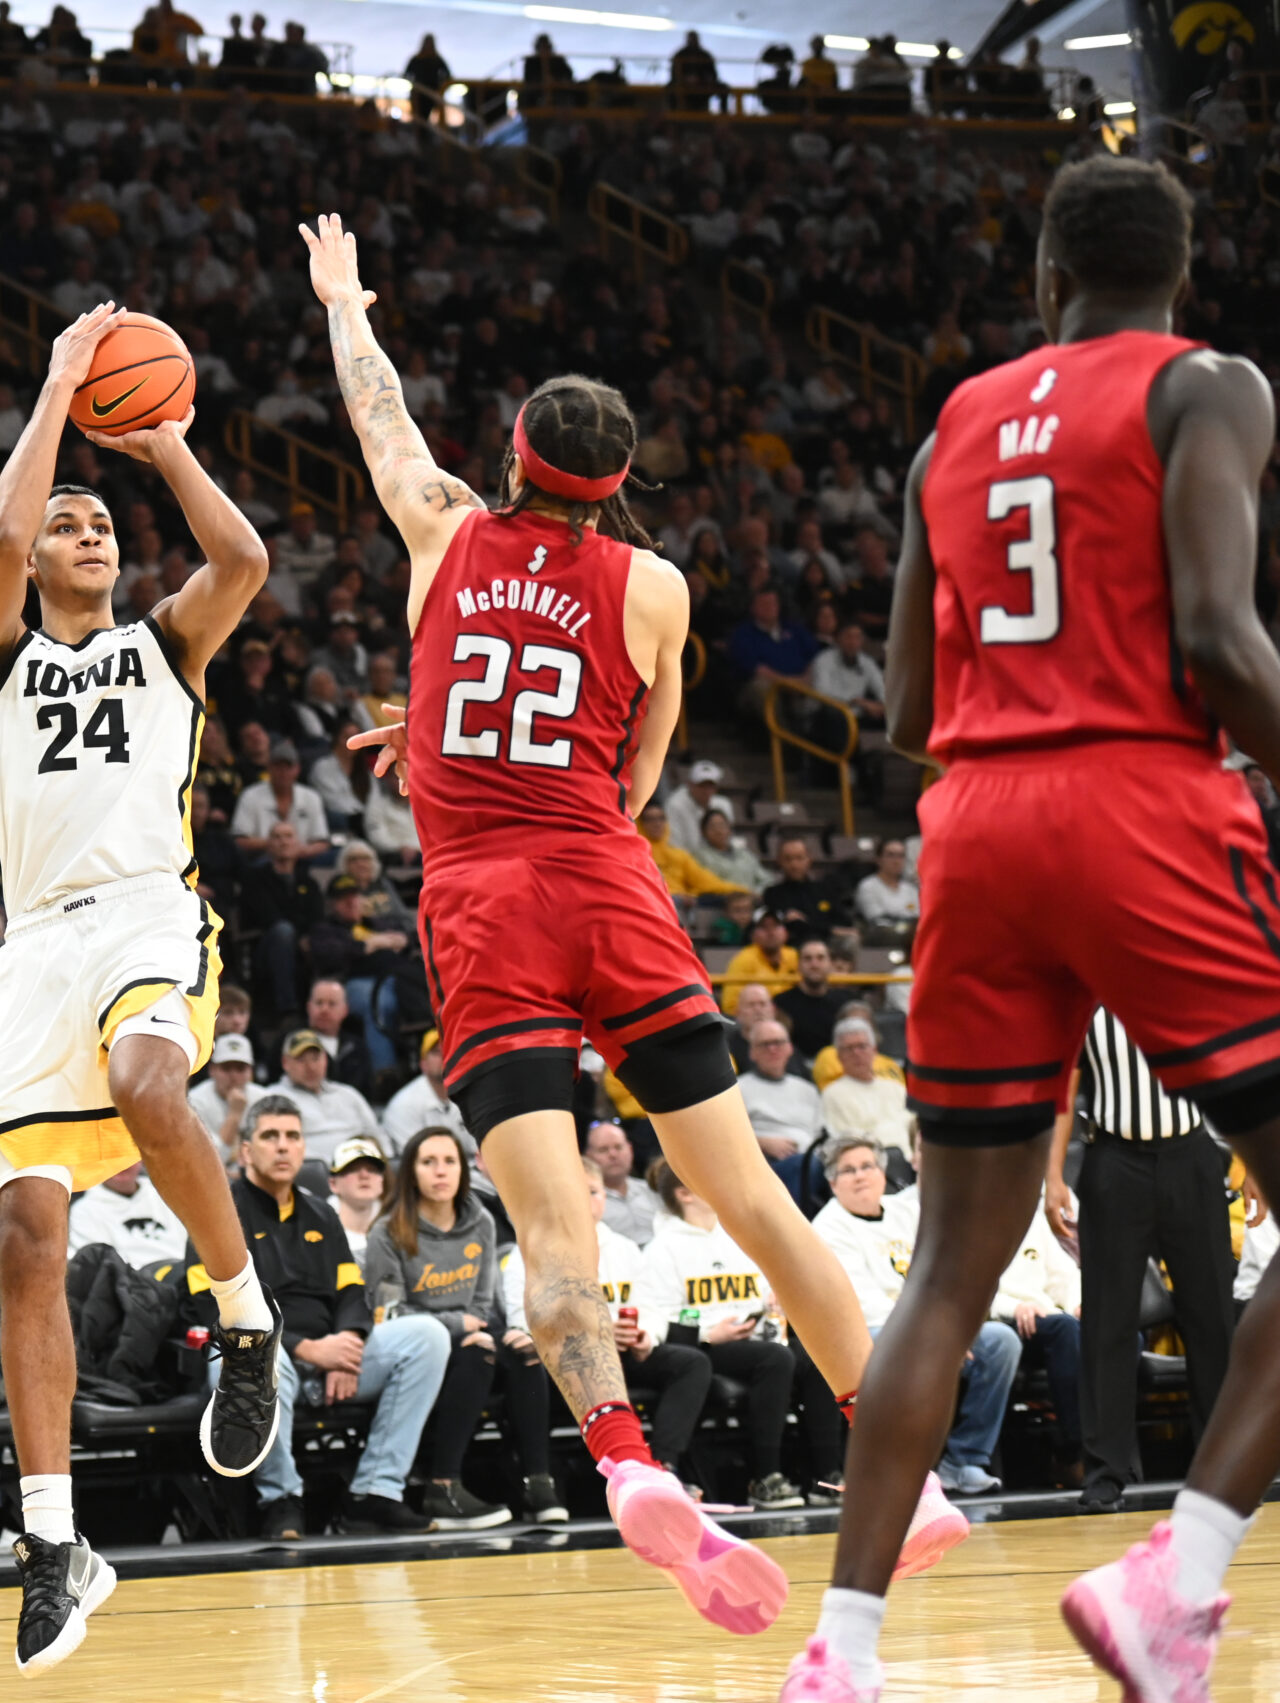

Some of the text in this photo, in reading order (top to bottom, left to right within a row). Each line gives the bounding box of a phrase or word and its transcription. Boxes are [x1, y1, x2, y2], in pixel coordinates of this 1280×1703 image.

[999, 414, 1060, 462] MAG
[980, 475, 1062, 644] 3
[456, 579, 592, 639] McCONNELL
[23, 648, 147, 698] IOWA
[441, 633, 583, 769] 22
[36, 698, 130, 775] 24
[63, 895, 96, 913] HAWKS
[685, 1274, 761, 1306] IOWA
